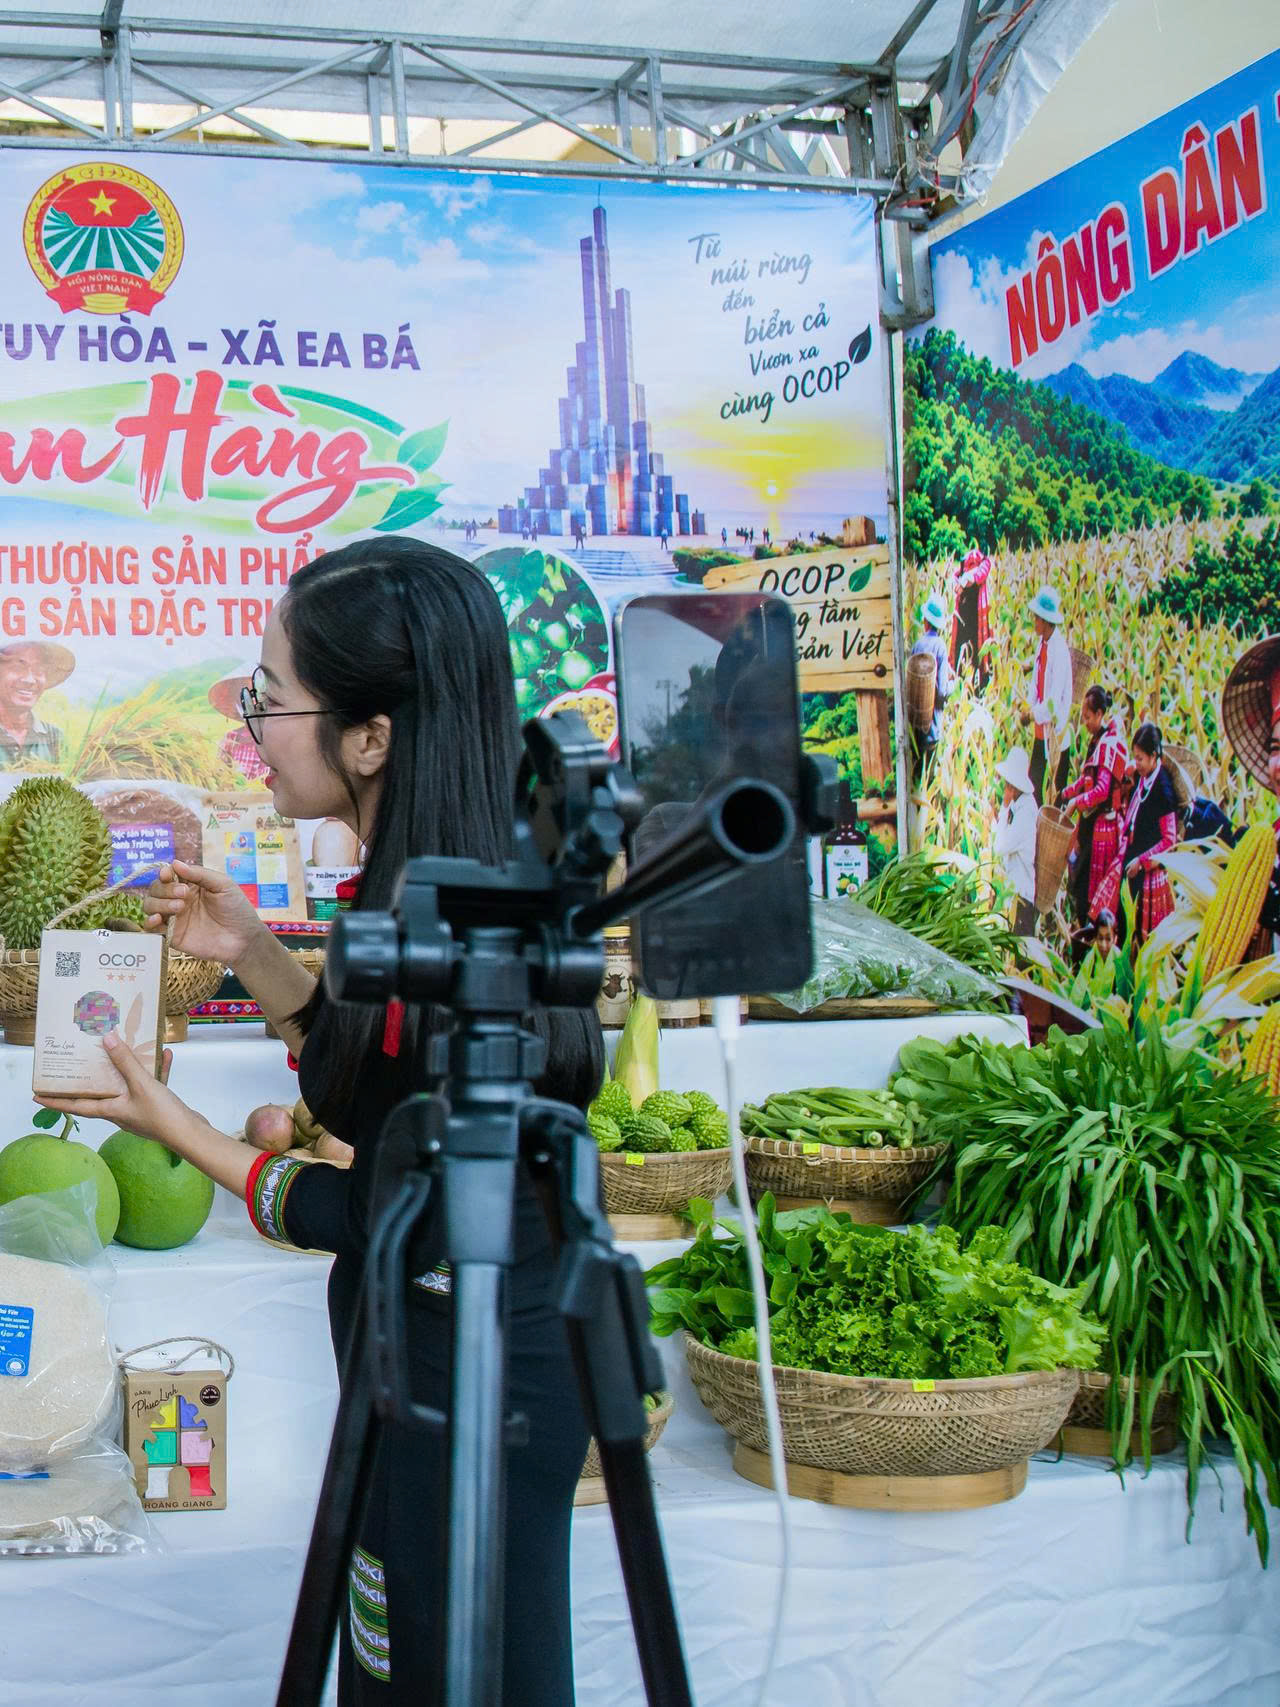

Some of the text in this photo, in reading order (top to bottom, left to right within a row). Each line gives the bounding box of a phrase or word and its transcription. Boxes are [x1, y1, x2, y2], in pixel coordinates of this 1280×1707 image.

[687, 233, 721, 264] Từ
[1006, 111, 1263, 368] NÔNG DÂN
[711, 252, 813, 286] núi rừng
[722, 288, 755, 312] đến
[744, 303, 830, 345] biển cả
[78, 314, 176, 363] HÒA
[221, 319, 282, 367] XÃ
[297, 330, 351, 369] EA
[364, 321, 420, 371] BÁ
[750, 345, 820, 376] Vươn xa
[720, 361, 851, 423] cùng OCOP
[113, 369, 416, 534] Hàng
[152, 536, 226, 585] SẢN
[239, 532, 326, 585] PHẨ
[759, 563, 845, 597] OCOP
[39, 587, 117, 637] SẢN
[129, 588, 206, 645] ĐẶC
[217, 598, 273, 636] TR
[819, 598, 861, 627] tầm
[842, 628, 889, 660] Việt
[98, 953, 147, 967] OCOP
[183, 1500, 213, 1508] GIANG
